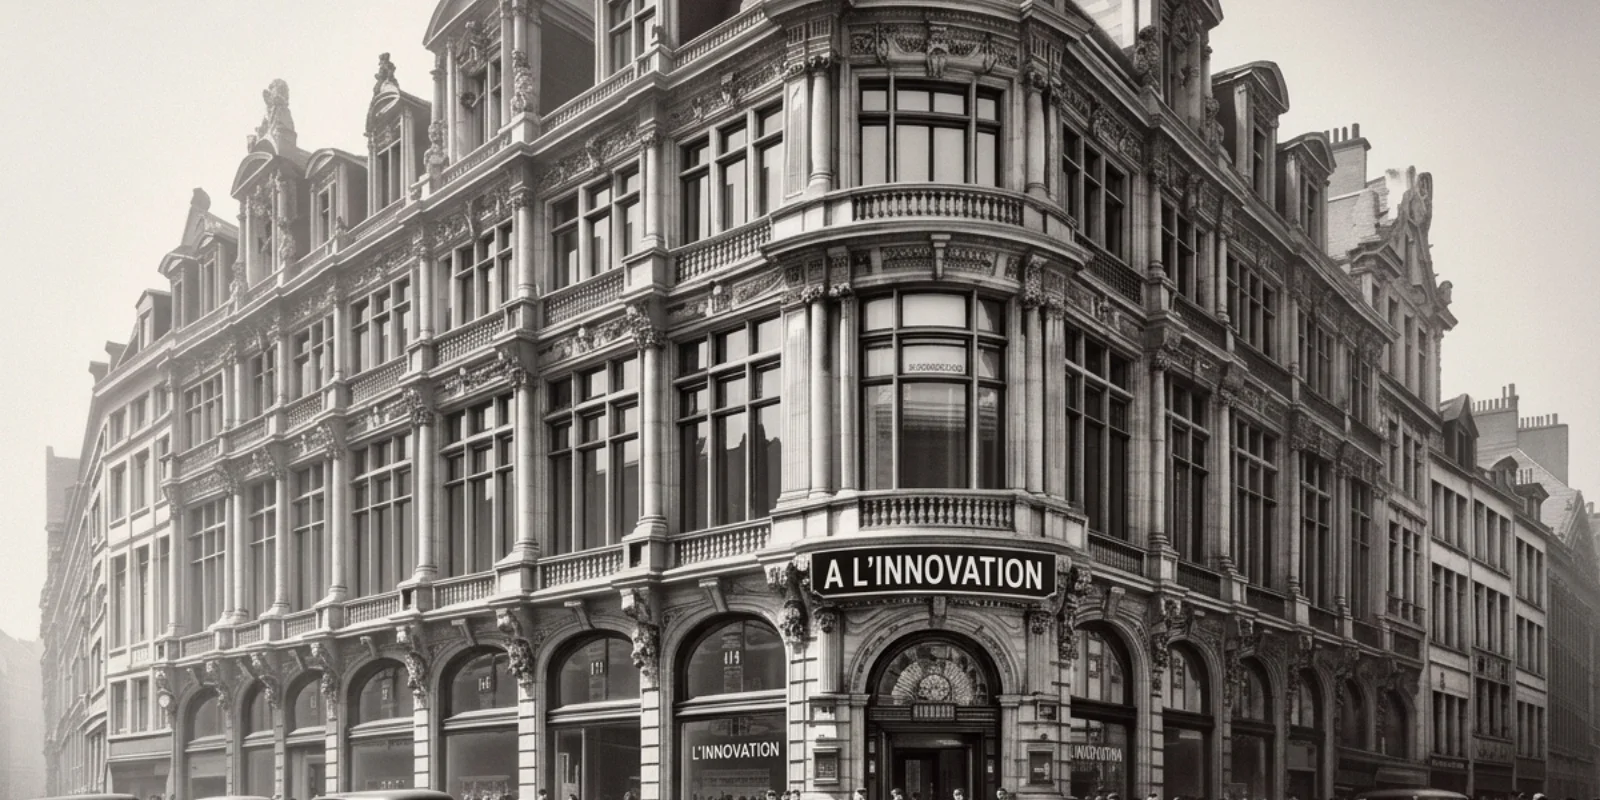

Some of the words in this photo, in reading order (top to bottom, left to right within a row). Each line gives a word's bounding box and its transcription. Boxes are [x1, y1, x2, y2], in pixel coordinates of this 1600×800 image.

[823, 559, 844, 590] A
[852, 554, 1043, 590] L'INNOVATION
[692, 741, 780, 761] L'INNOVATION
